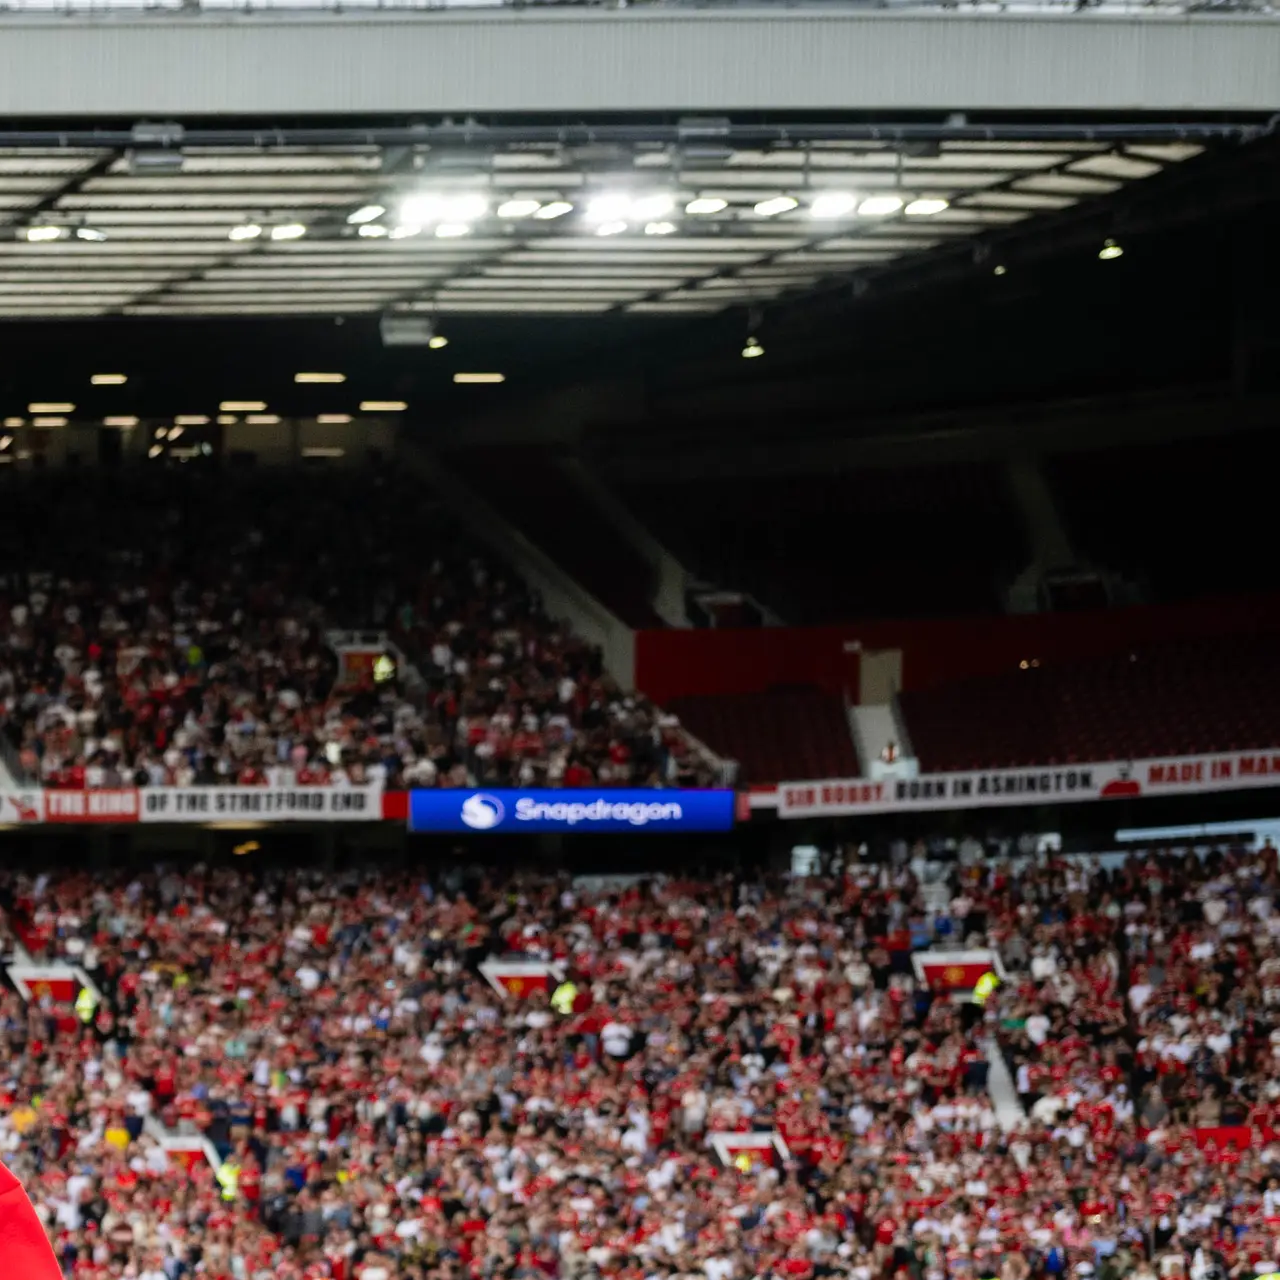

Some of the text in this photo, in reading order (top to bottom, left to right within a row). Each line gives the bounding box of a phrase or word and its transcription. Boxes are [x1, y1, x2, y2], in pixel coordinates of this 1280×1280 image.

[1148, 761, 1203, 784] MADE
[1211, 760, 1231, 779] IN
[954, 779, 972, 798] IN
[146, 793, 168, 811] OF
[176, 793, 209, 811] THE
[215, 793, 324, 811] STRETFORD
[331, 793, 365, 811] END
[514, 796, 683, 826] Snapdragon
